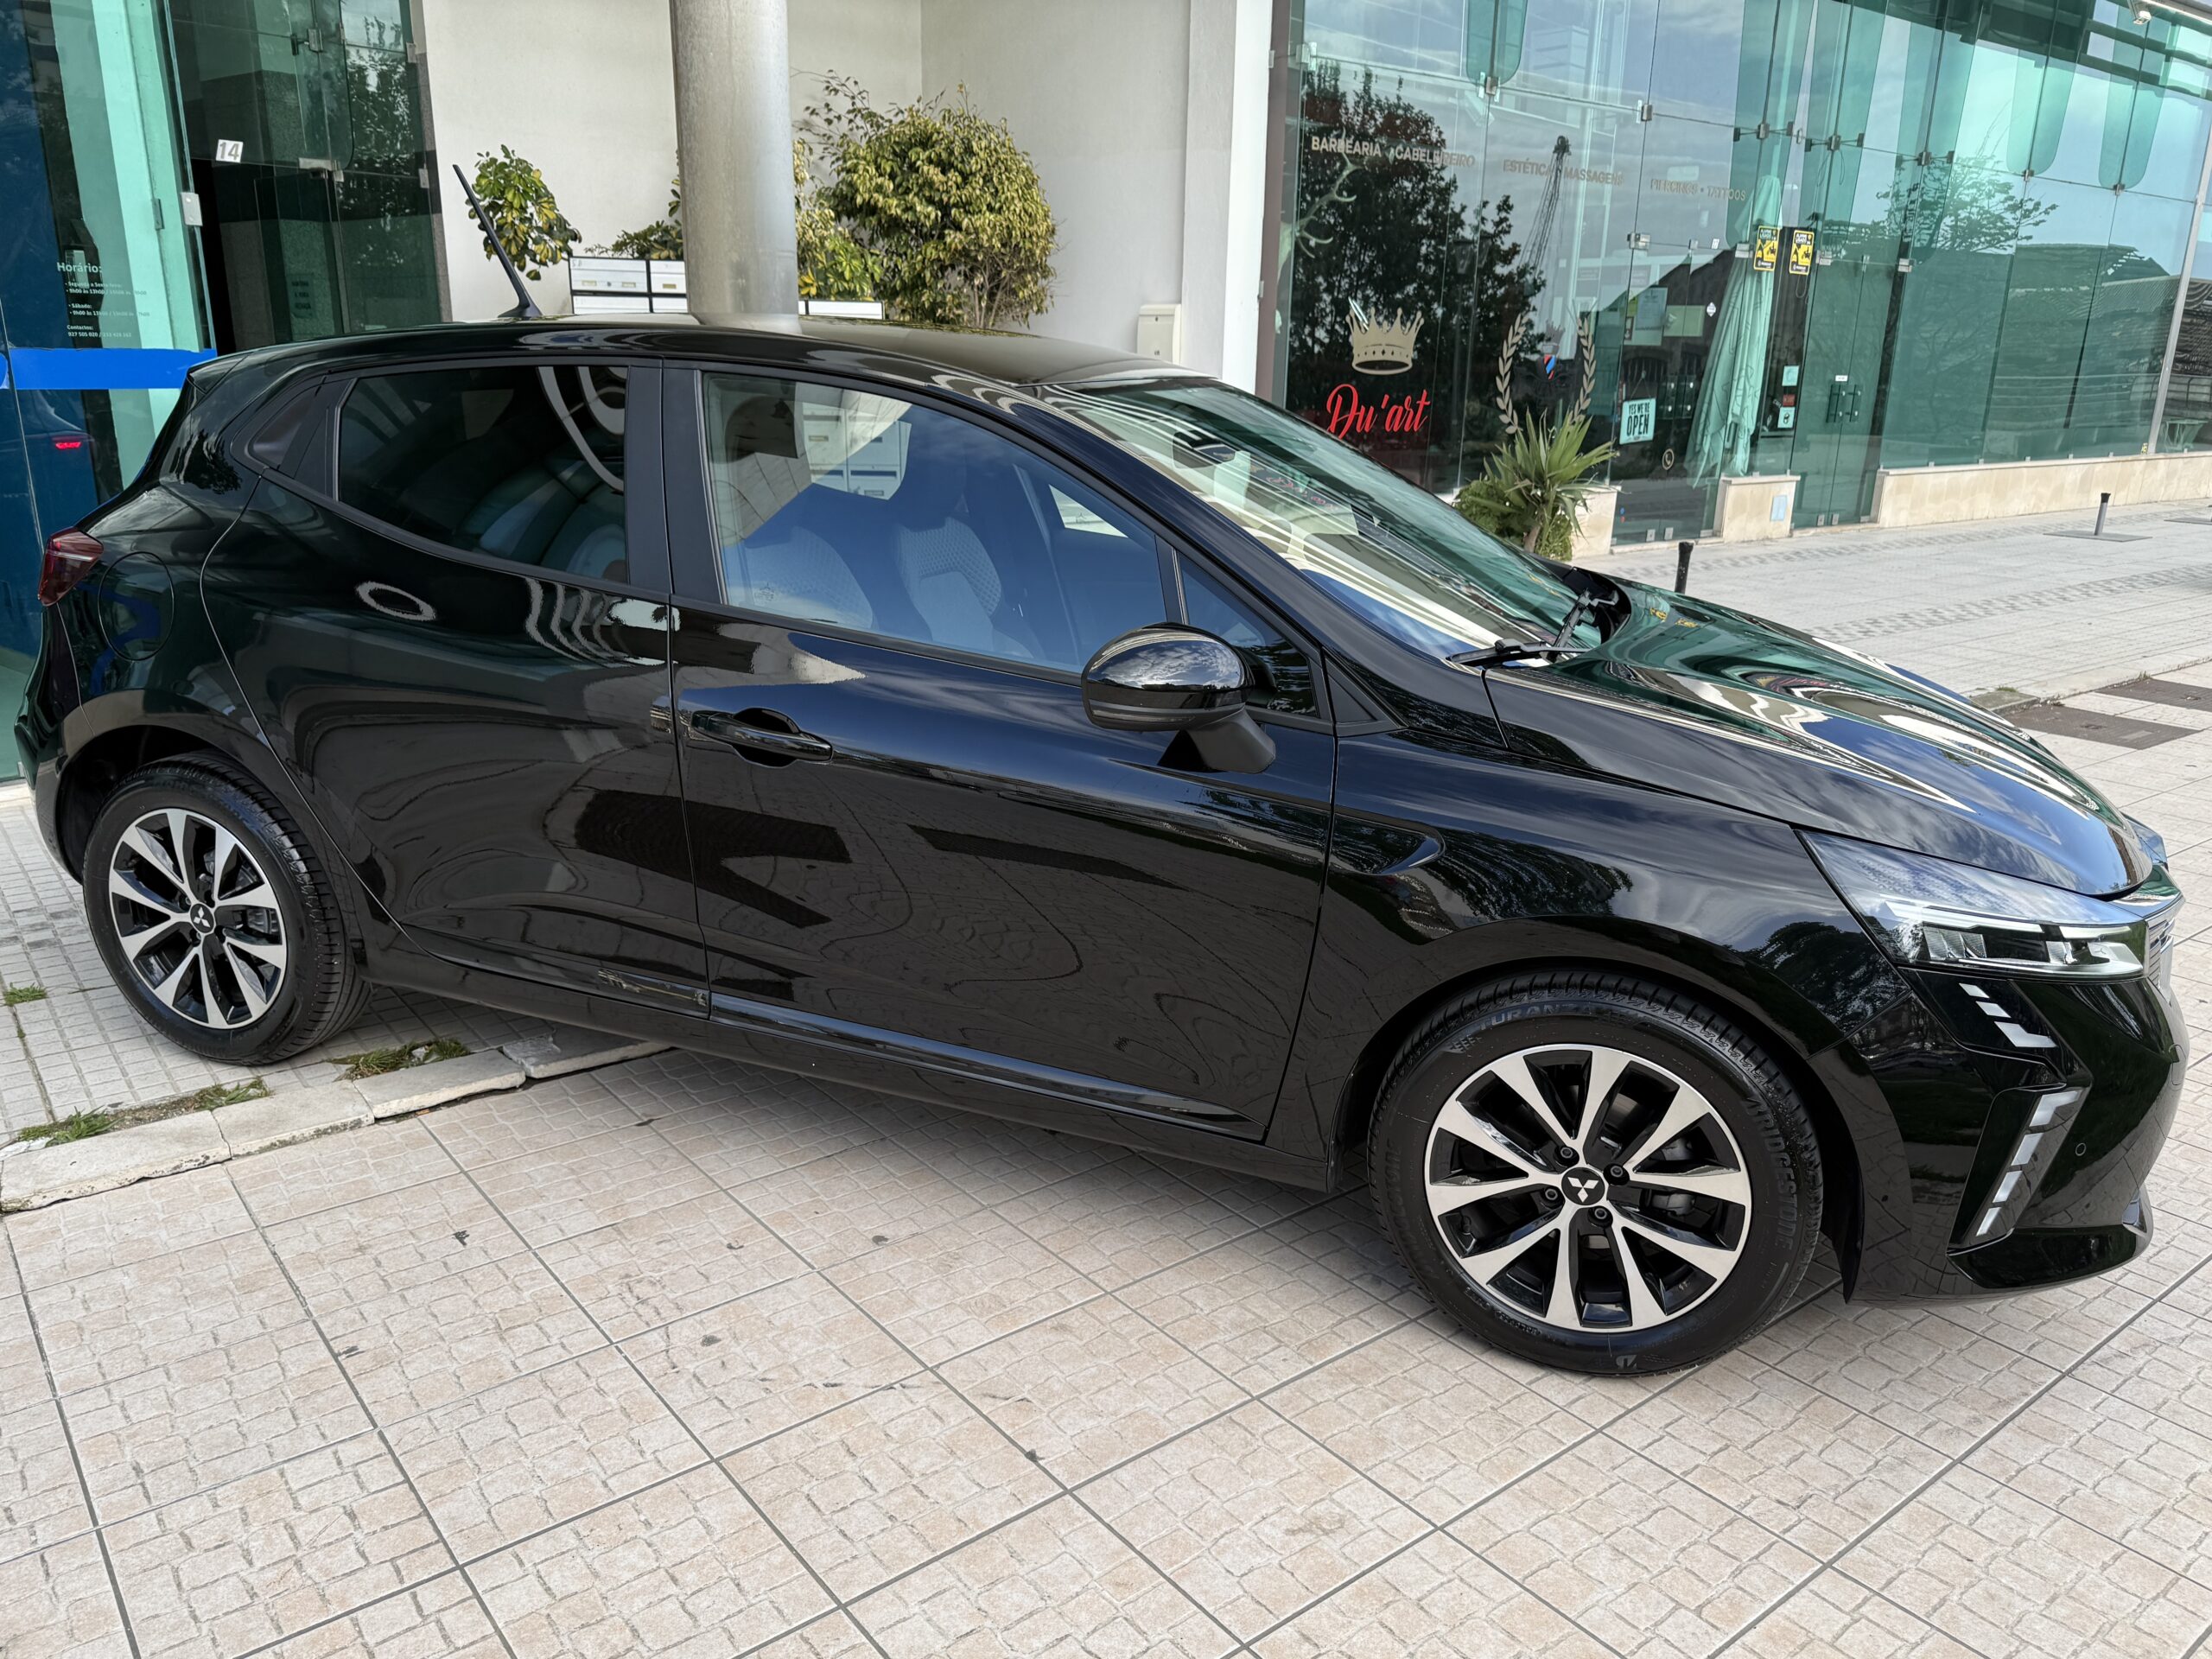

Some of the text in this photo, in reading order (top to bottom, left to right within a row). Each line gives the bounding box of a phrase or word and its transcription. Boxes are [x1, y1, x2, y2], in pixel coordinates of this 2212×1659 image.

[219, 142, 239, 160] 14
[1312, 136, 1382, 157] BARBEARIA
[1503, 158, 1624, 186] ESTÉTICA MASSAGENS
[1707, 186, 1745, 201] TATTOOS
[56, 262, 103, 273] Horário:
[1637, 403, 1649, 414] WE'RE
[1626, 414, 1649, 436] OPEN
[1739, 1096, 1798, 1251] BRIDGESTONE
